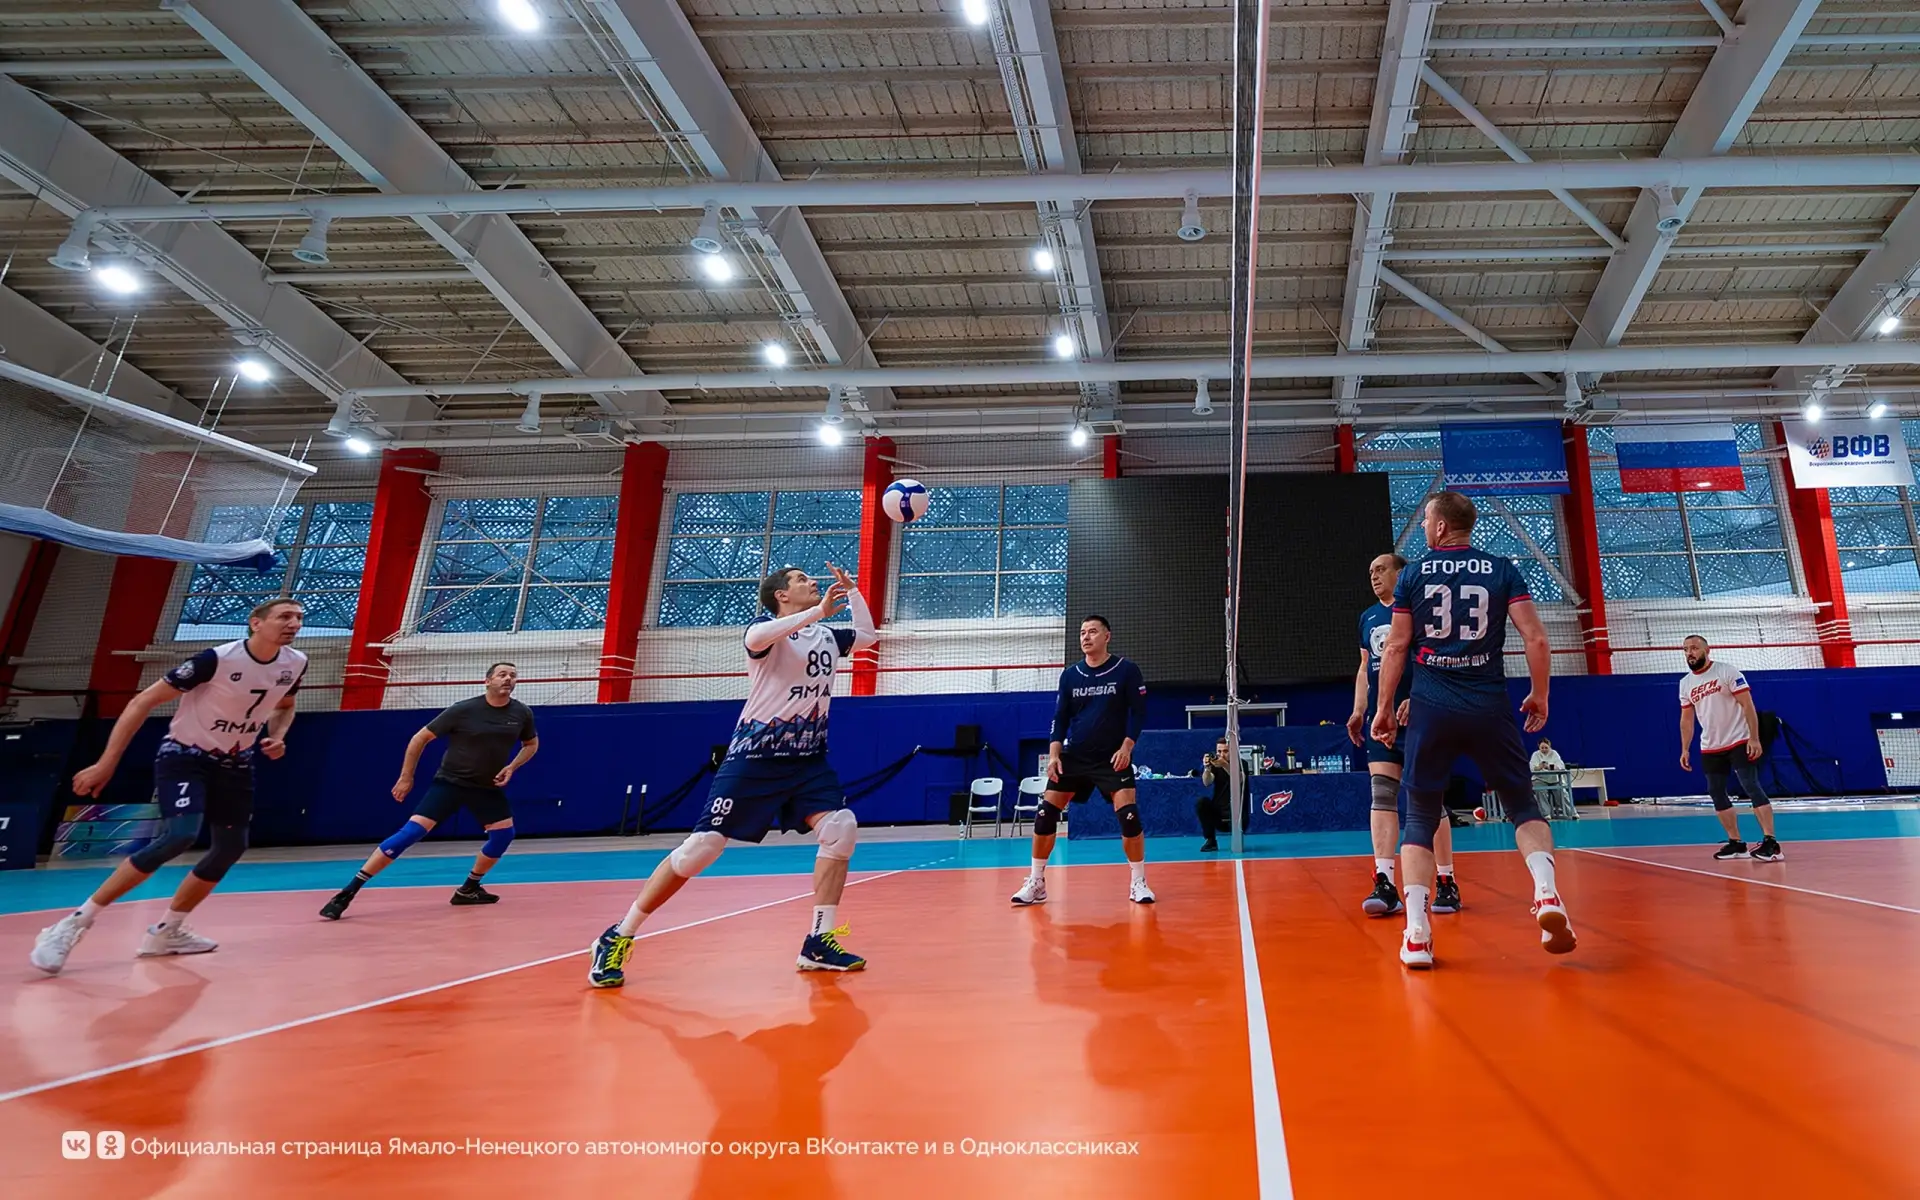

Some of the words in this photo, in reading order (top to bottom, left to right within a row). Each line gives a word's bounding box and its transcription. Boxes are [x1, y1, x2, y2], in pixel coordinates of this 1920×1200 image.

[1832, 434, 1890, 458] ВФВ
[1421, 558, 1493, 575] ЕГОРОВ
[1424, 584, 1489, 640] 33
[806, 650, 832, 678] 89
[1072, 682, 1117, 697] RUSSIA
[1690, 679, 1717, 697] БЕГИ
[246, 689, 268, 719] 7
[178, 782, 189, 795] 7
[711, 797, 733, 815] 89
